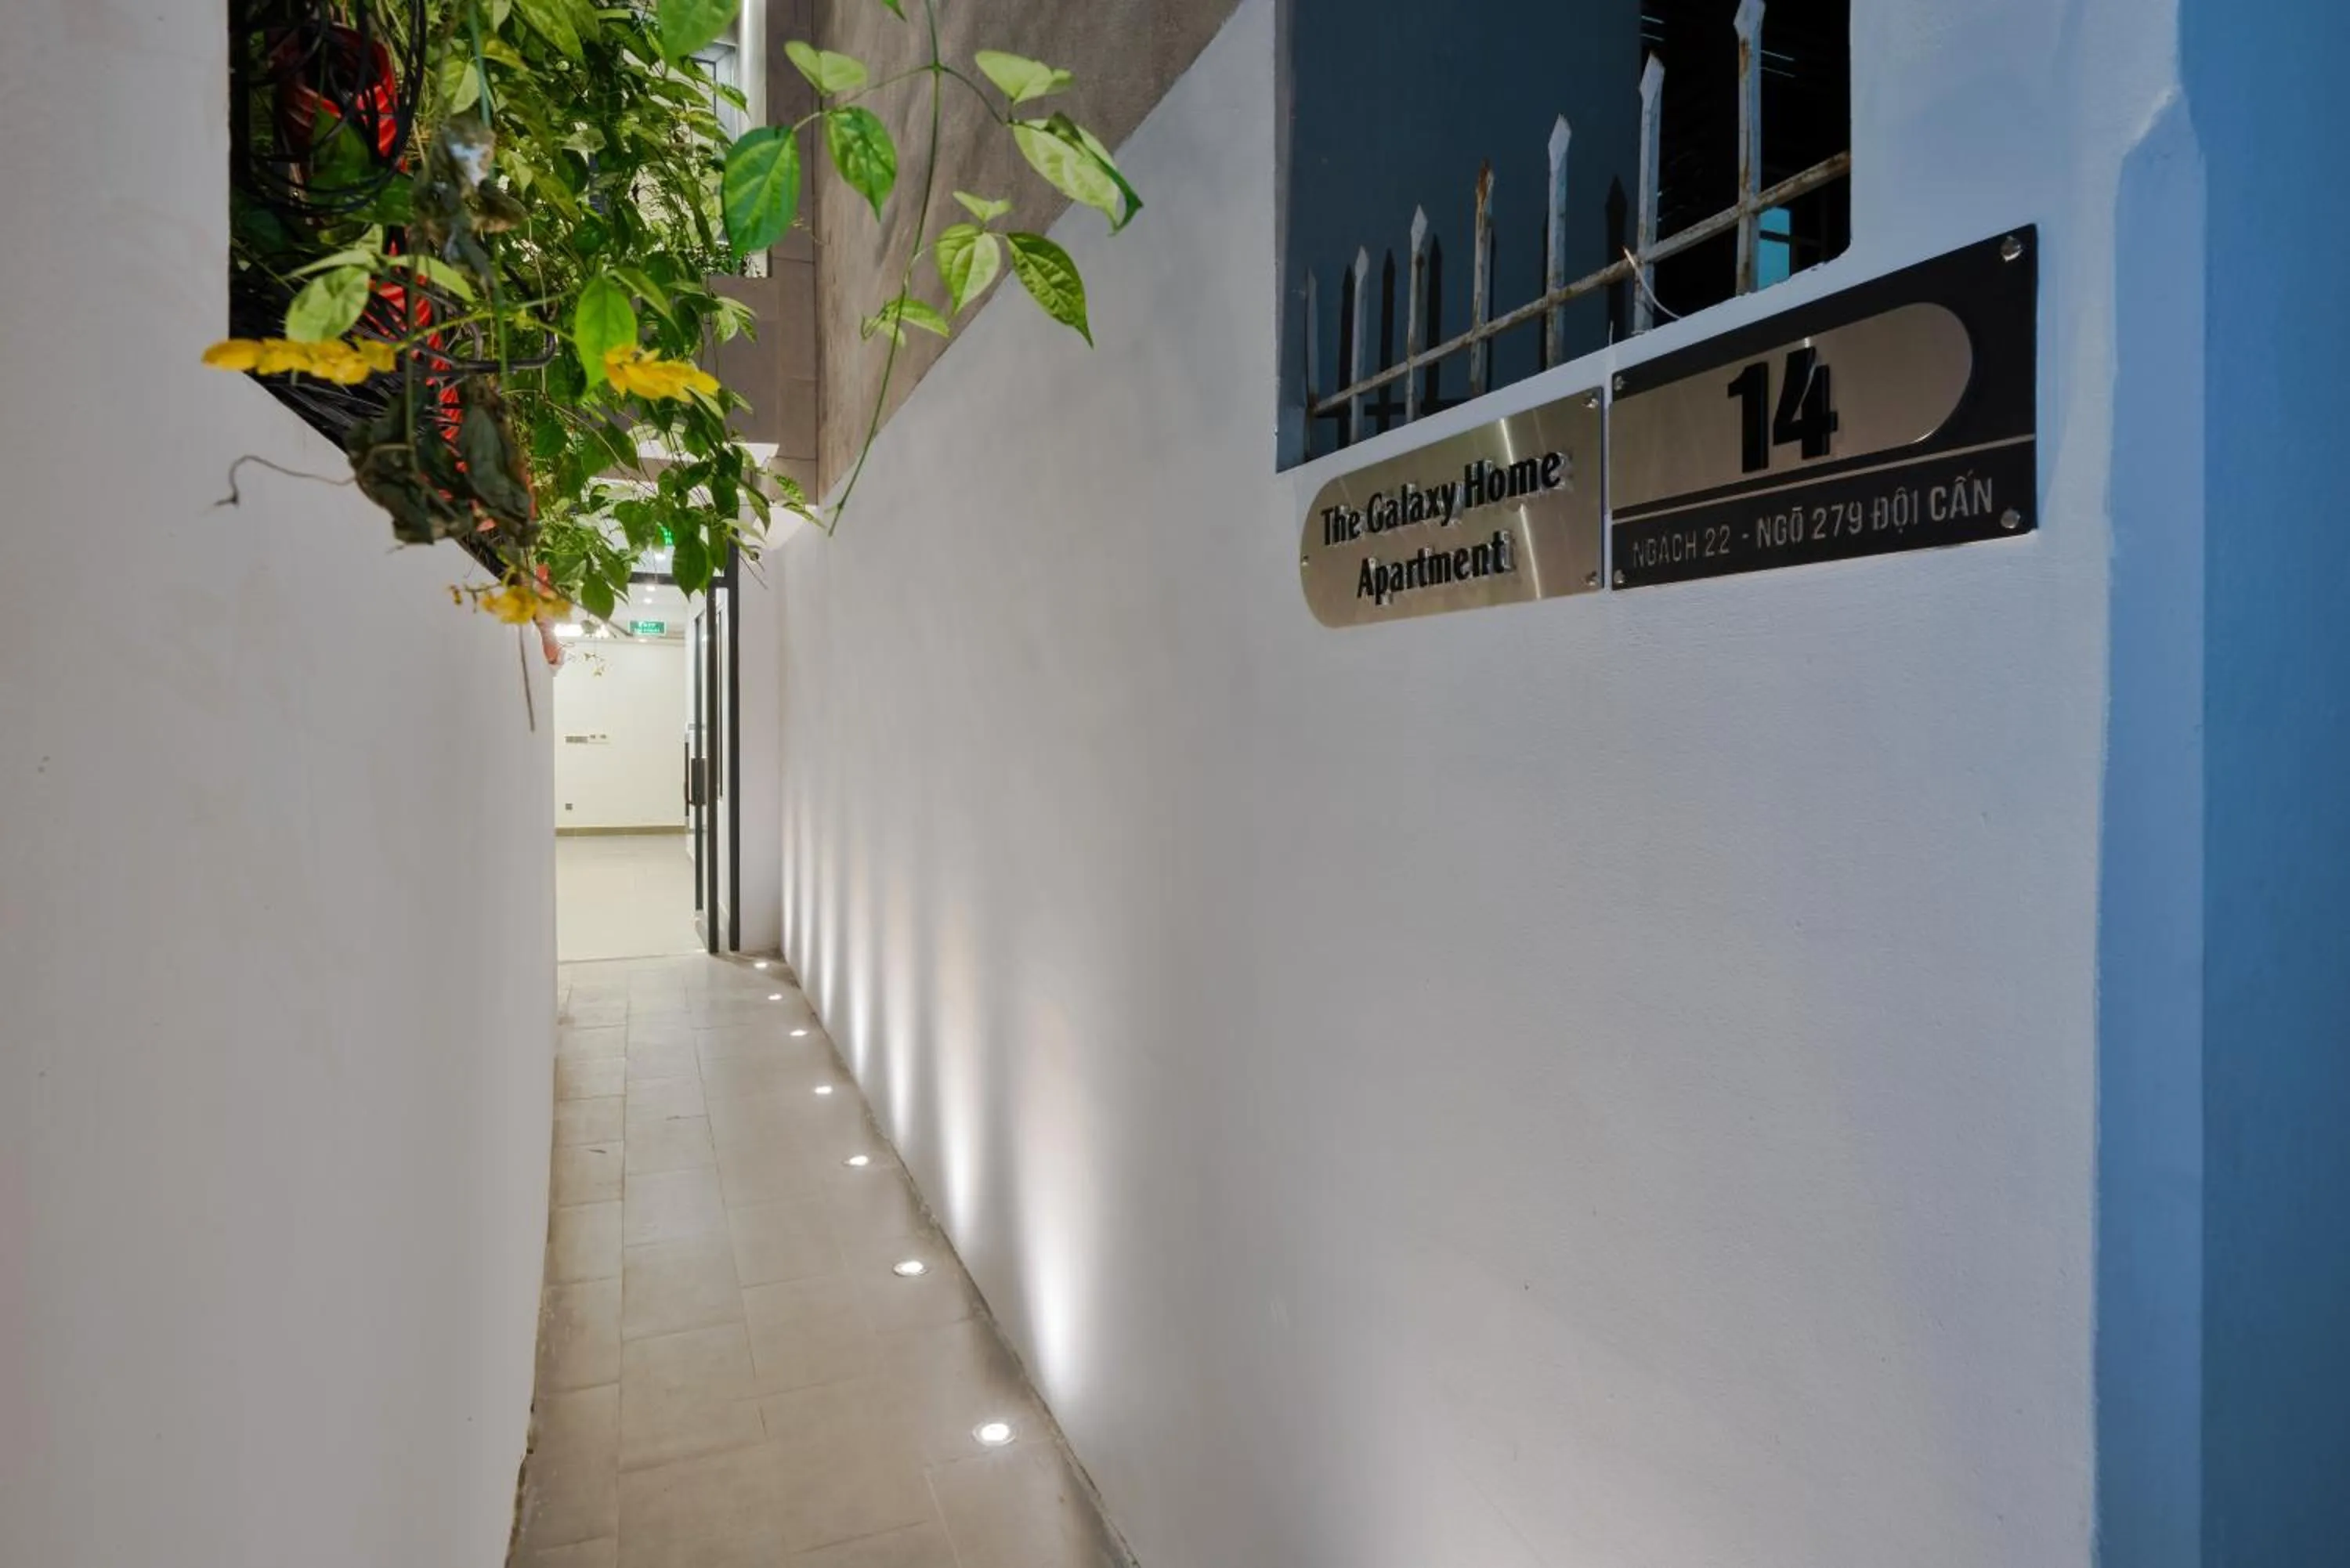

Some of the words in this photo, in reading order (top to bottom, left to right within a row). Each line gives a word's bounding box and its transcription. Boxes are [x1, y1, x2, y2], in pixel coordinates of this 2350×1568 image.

[1727, 345, 1838, 473] 14
[1321, 504, 1361, 546] The
[1366, 482, 1459, 533] Galaxy
[1463, 451, 1568, 509] Home
[1705, 523, 1731, 558] 22
[1756, 506, 1804, 550] NGÕ
[1811, 500, 1863, 540] 279
[1870, 486, 1919, 533] ĐỘI
[1929, 469, 1993, 522] CẤN
[1357, 529, 1510, 605] Apartment
